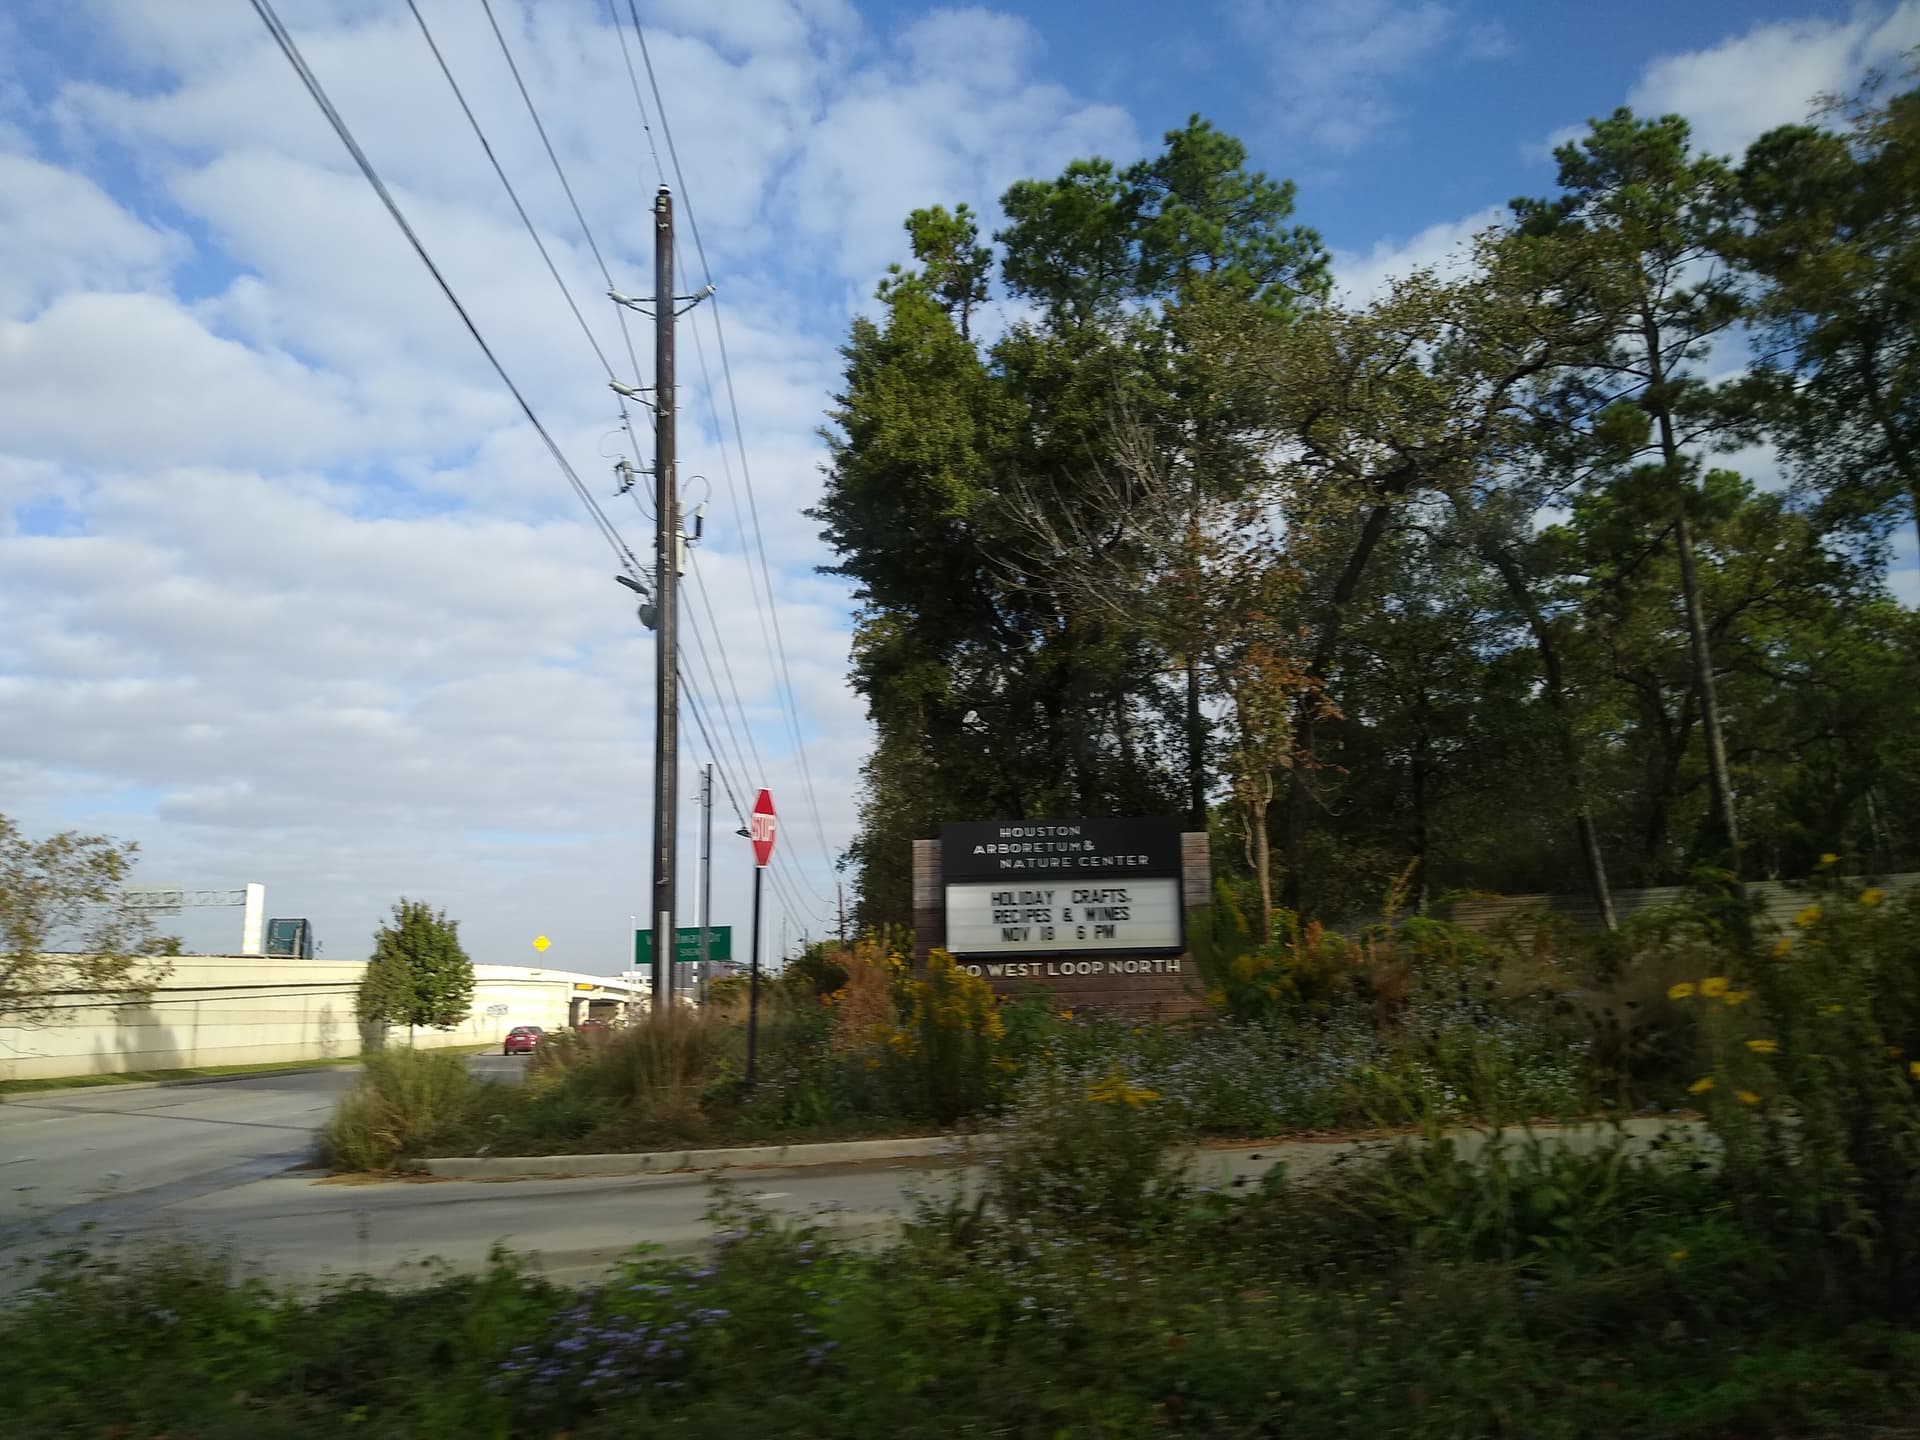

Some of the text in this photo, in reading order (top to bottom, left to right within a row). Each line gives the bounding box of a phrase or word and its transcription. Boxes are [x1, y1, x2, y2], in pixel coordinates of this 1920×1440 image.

[1000, 826, 1081, 838] HOUSTON
[1000, 855, 1149, 868] NATURE CENTER
[991, 890, 1054, 906] HOLIDAY
[993, 906, 1130, 924] RECIPES & WINES
[1002, 926, 1030, 942] NOV
[1094, 924, 1116, 939] PM
[986, 962, 1043, 977] WEST
[1047, 961, 1104, 976] LOOP
[1108, 959, 1181, 974] NORTH
